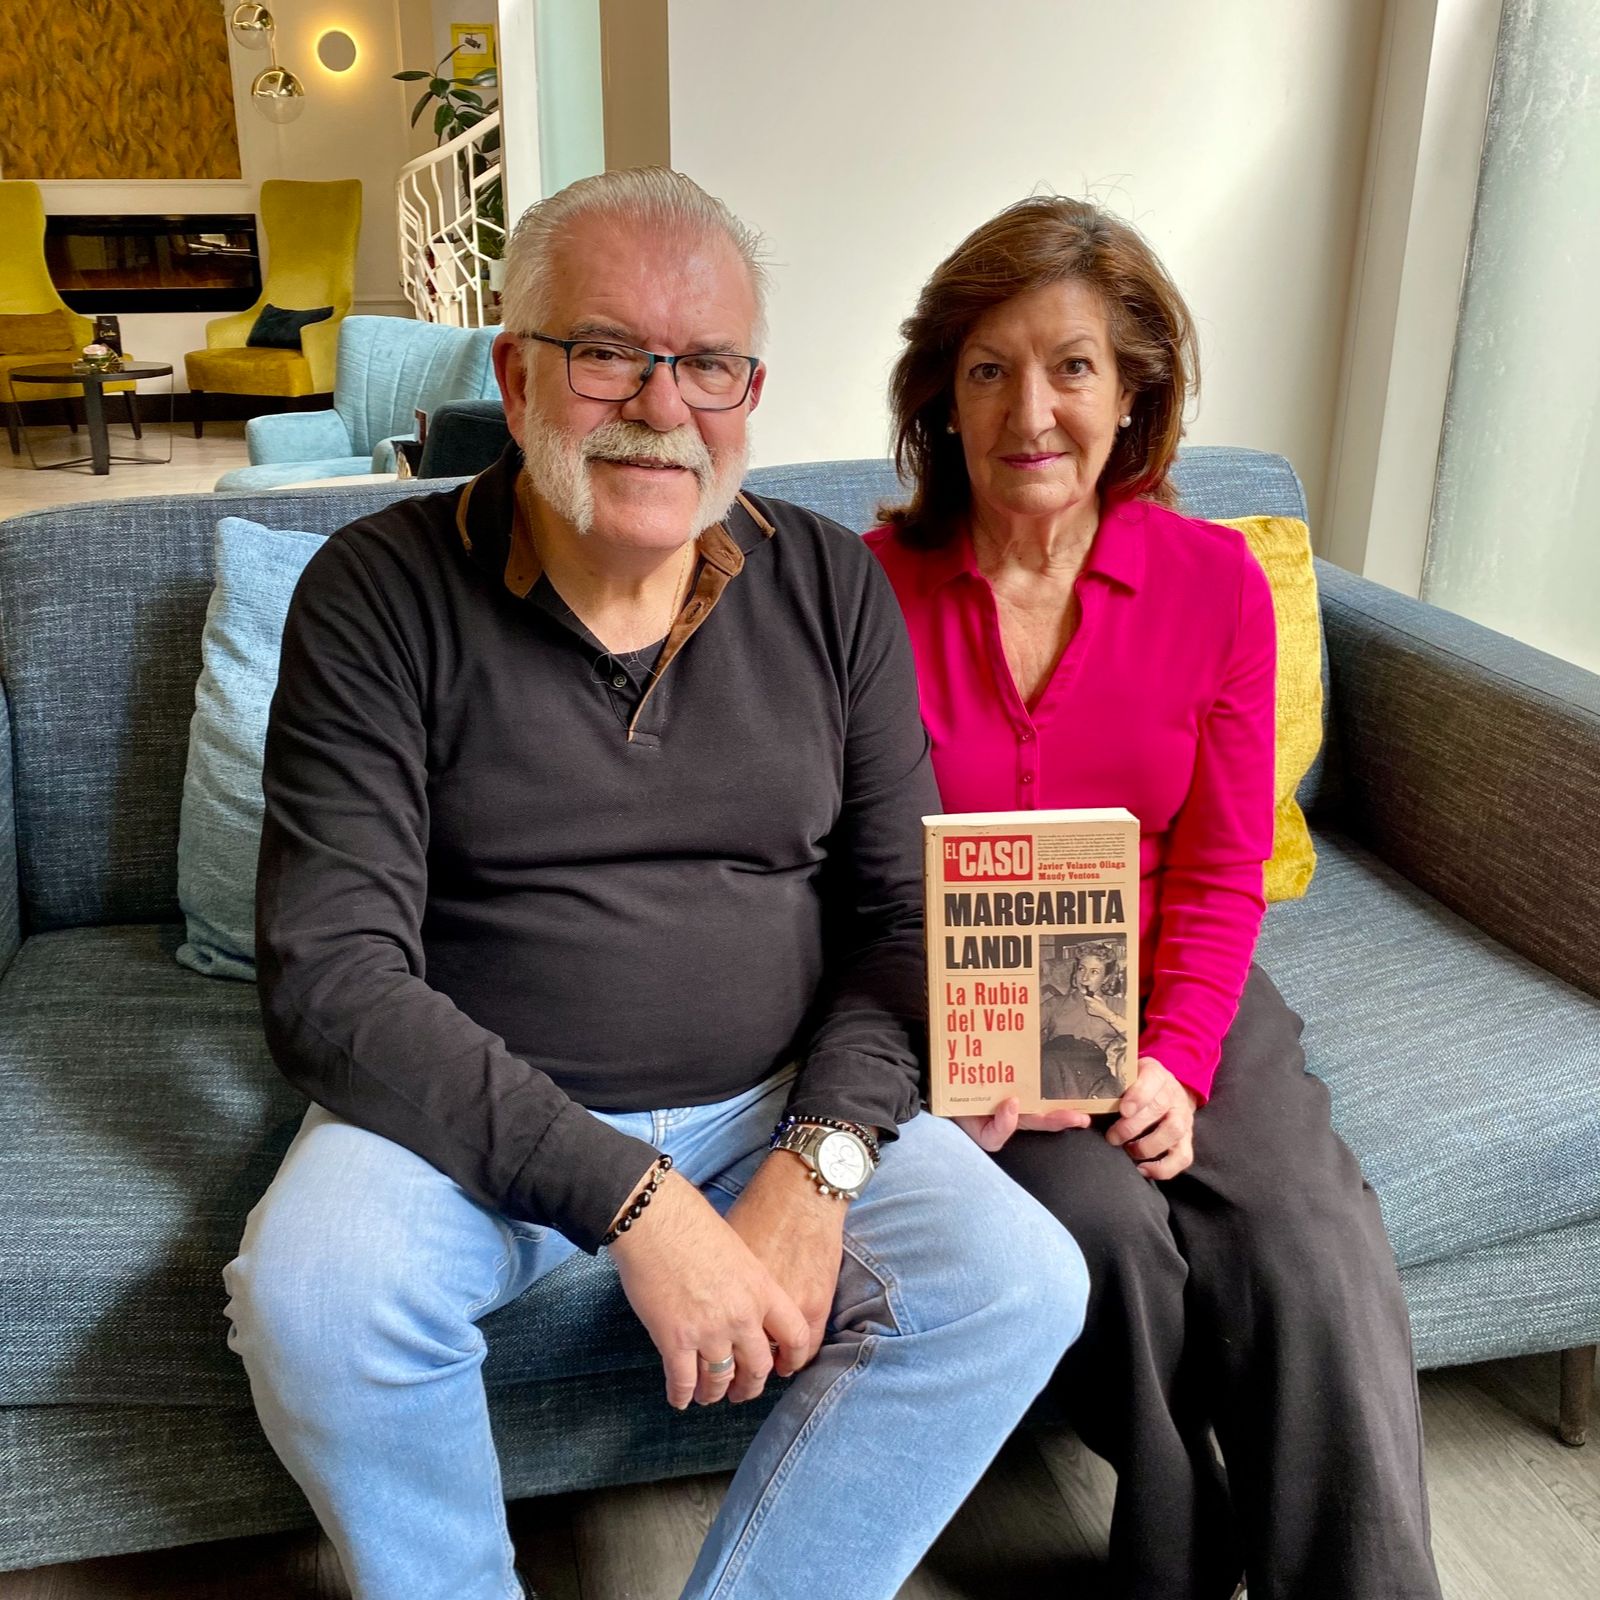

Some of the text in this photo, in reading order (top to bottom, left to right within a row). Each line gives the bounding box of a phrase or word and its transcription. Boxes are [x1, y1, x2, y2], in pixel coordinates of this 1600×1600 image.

[945, 843, 959, 859] EL
[959, 840, 1030, 877] CASO
[1038, 862, 1064, 870] Javier
[1066, 862, 1097, 870] Velasco
[1038, 872, 1066, 881] Maudy
[944, 889, 1125, 927] MARGARITA
[945, 935, 1032, 969] LANDI
[946, 982, 1028, 1006] La Rubia
[947, 1008, 1024, 1032] del Velo
[947, 1034, 982, 1060] y la
[948, 1061, 1015, 1084] Pistola
